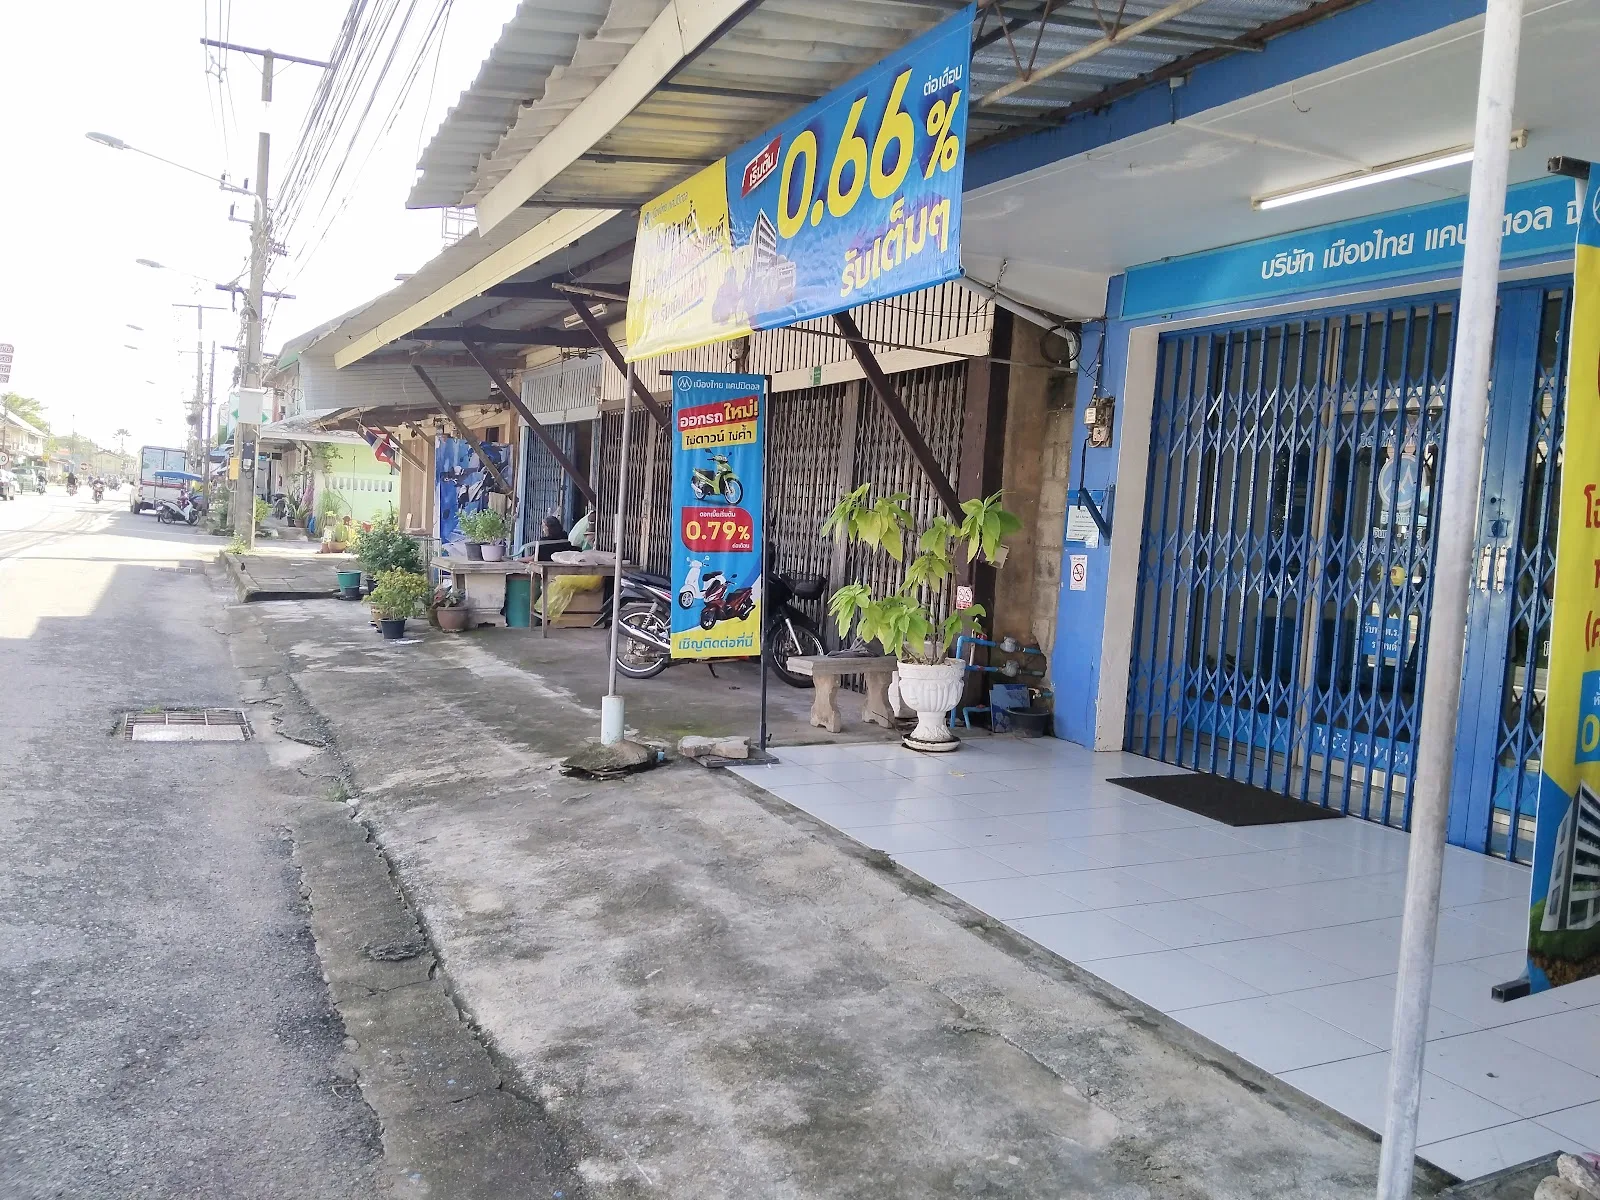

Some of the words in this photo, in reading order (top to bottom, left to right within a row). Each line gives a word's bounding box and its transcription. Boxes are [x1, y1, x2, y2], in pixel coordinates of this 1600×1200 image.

[924, 64, 962, 96] ต่อเดือน
[749, 152, 774, 187] เริ่มต้น
[839, 197, 951, 298] รับเต็มๆ
[1261, 248, 1314, 280] บริษัท
[1323, 229, 1415, 268] เมืองไทย
[693, 379, 723, 389] เมืองไทย
[725, 381, 760, 391] แคปปิตอล
[680, 411, 723, 428] ออกรถ
[723, 399, 759, 421] ใหม่!
[686, 429, 725, 446] ไม่ดาวน์
[686, 520, 751, 540] 0.79%
[678, 632, 754, 652] เชิญติดต่อที่นี่
